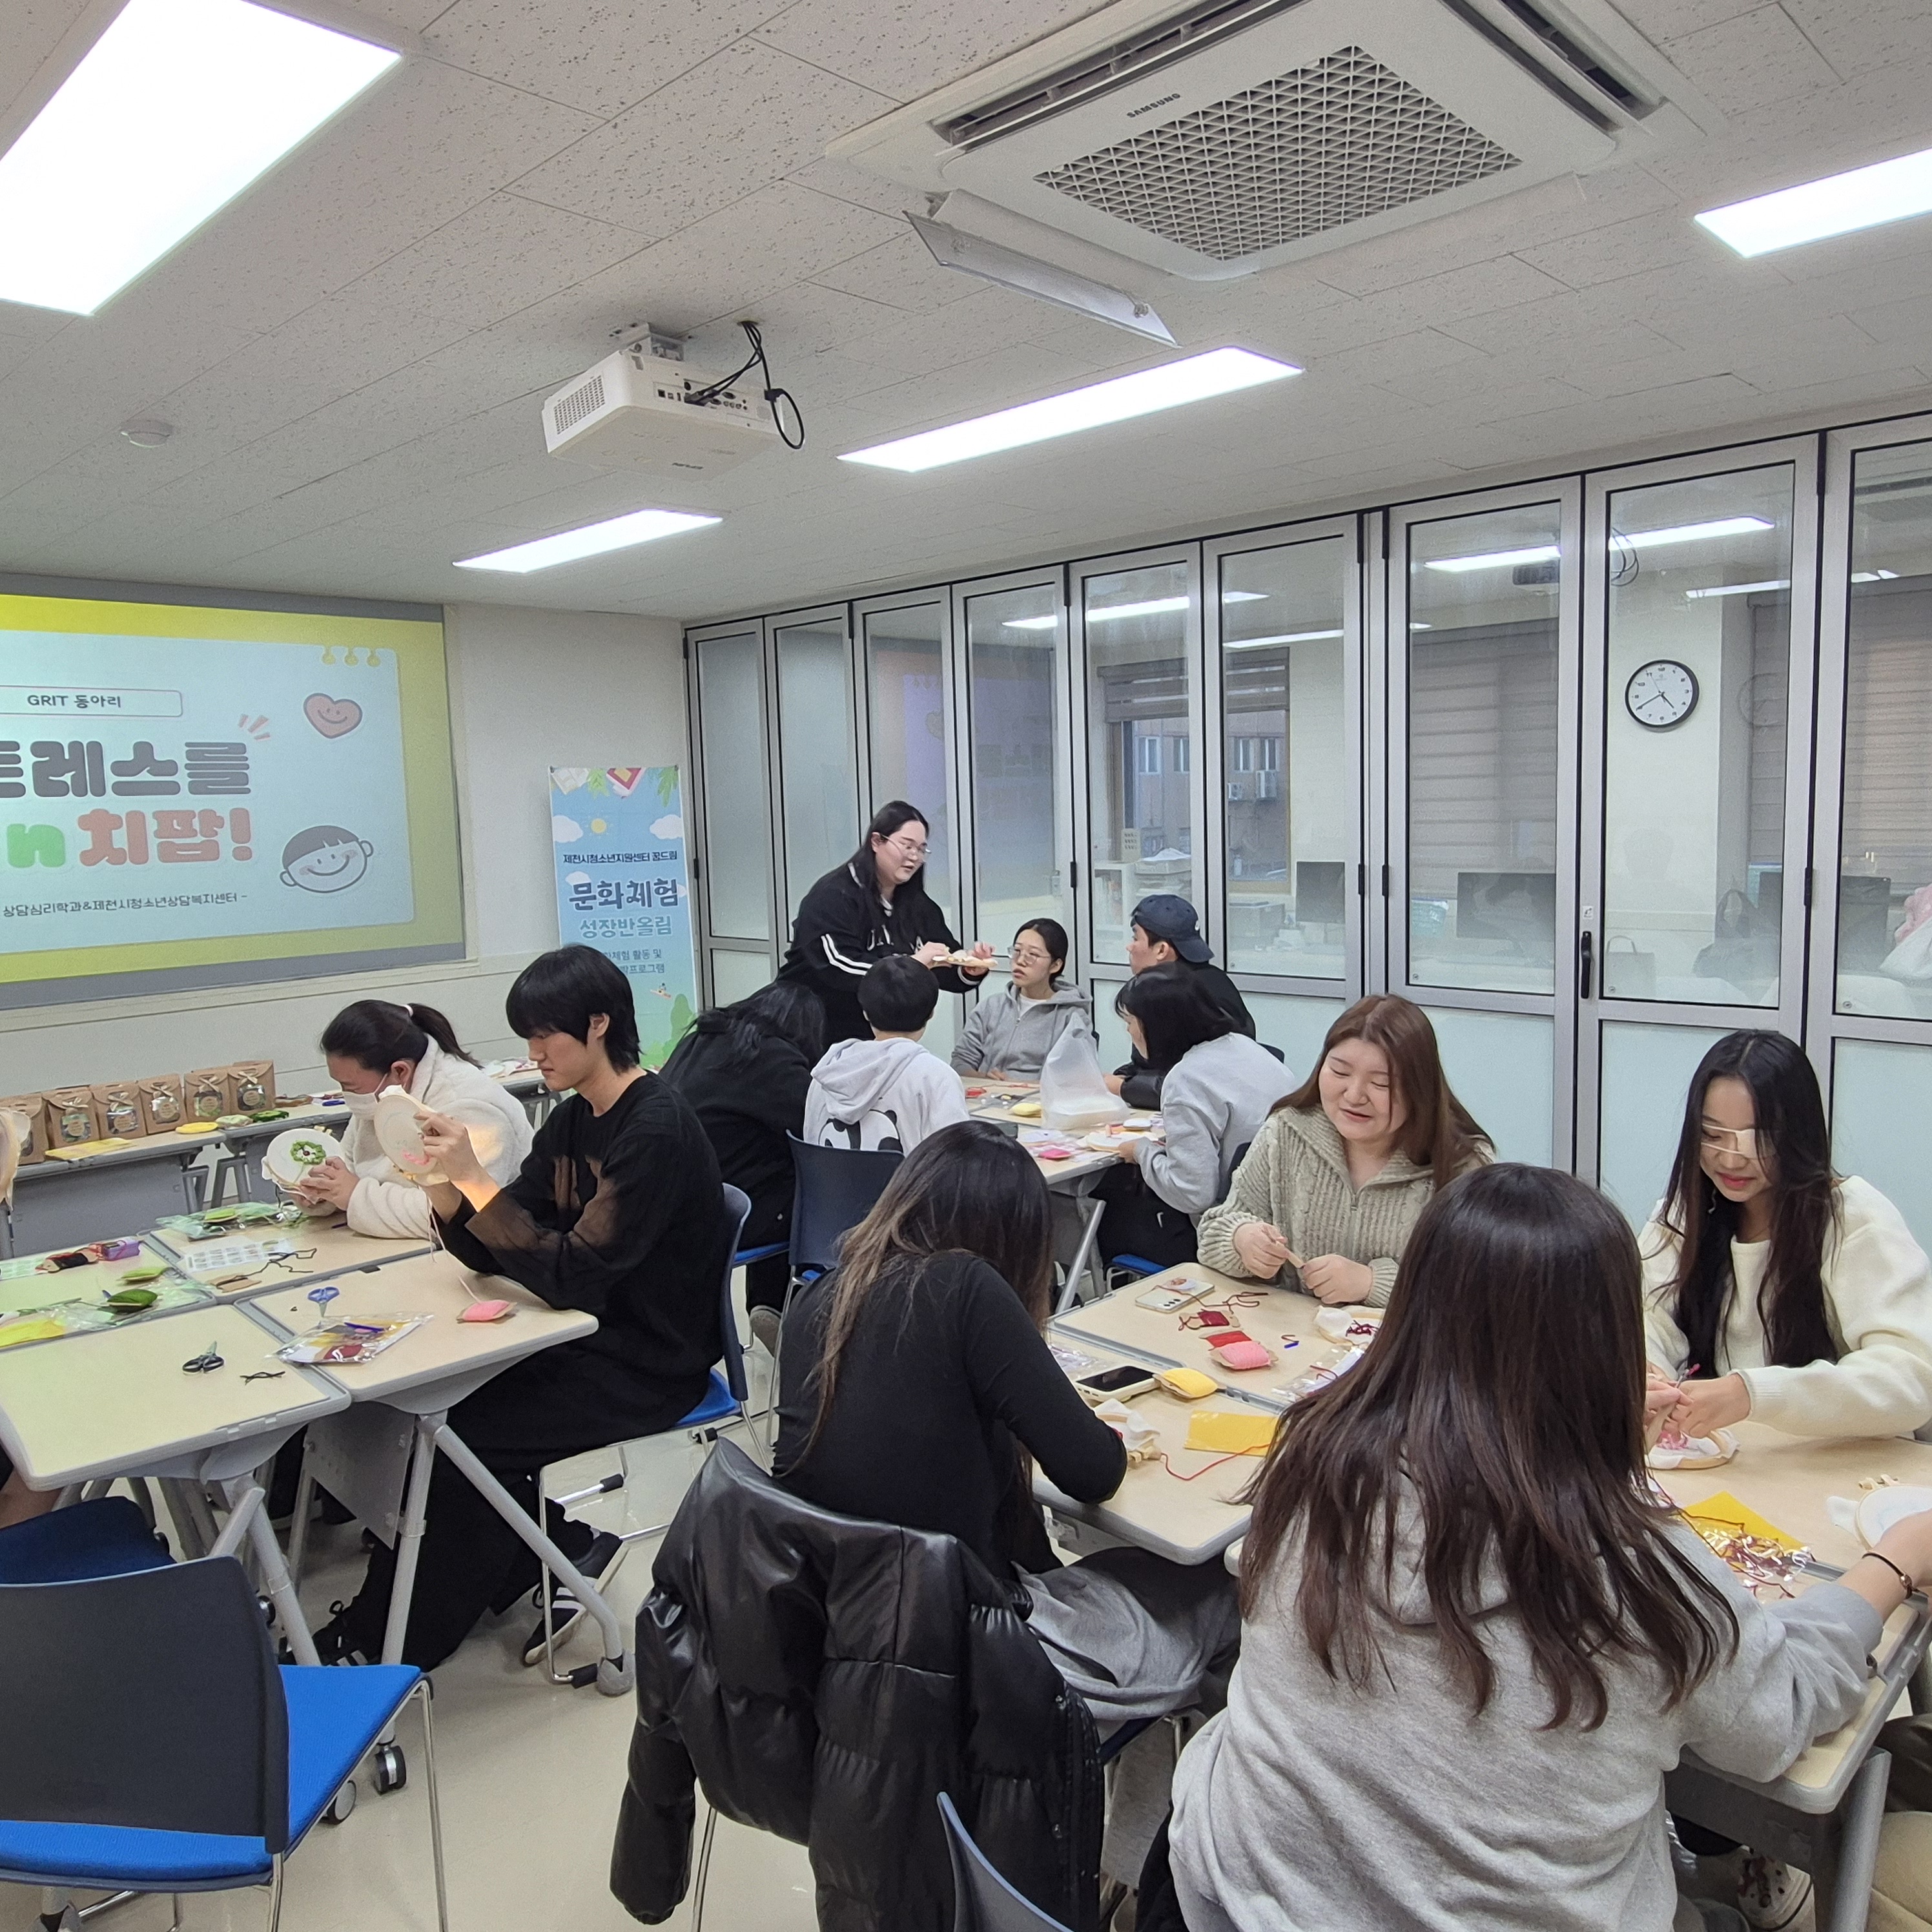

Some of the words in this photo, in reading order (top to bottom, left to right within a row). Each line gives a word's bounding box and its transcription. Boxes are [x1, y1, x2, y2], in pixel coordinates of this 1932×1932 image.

[1126, 92, 1181, 118] SAMSUNG
[27, 694, 68, 706] GRIT
[74, 694, 121, 708] 동아리
[562, 852, 650, 864] 제천시청소년지원센터
[652, 850, 677, 862] 꿈드림
[568, 878, 679, 911] 문화체험
[580, 915, 672, 939] 성장반올림
[652, 948, 662, 960] 및
